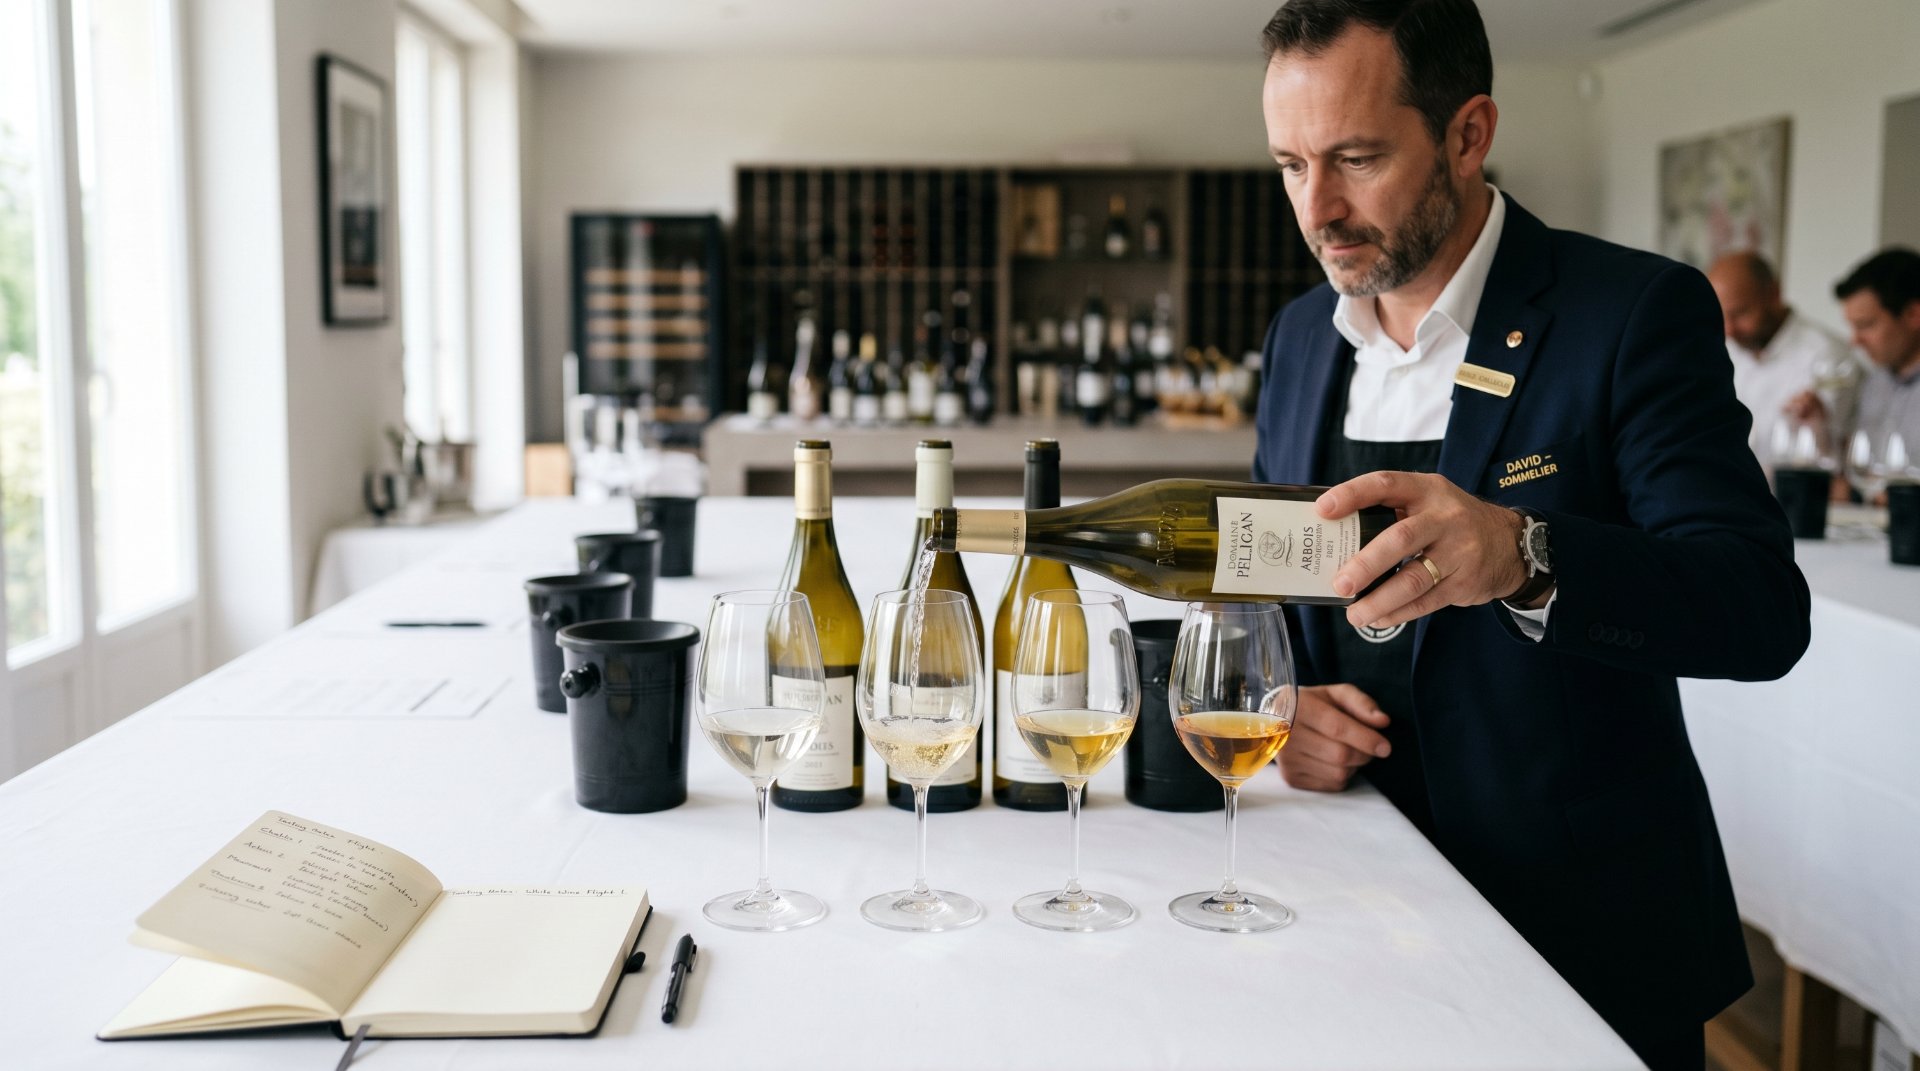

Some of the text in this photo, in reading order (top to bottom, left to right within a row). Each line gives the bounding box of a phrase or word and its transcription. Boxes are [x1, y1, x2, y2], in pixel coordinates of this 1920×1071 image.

[1499, 463, 1558, 488] SOMMELIER
[1506, 454, 1541, 474] DAVID
[1228, 520, 1239, 570] DOMAINE
[1300, 526, 1314, 571] ARBOIS
